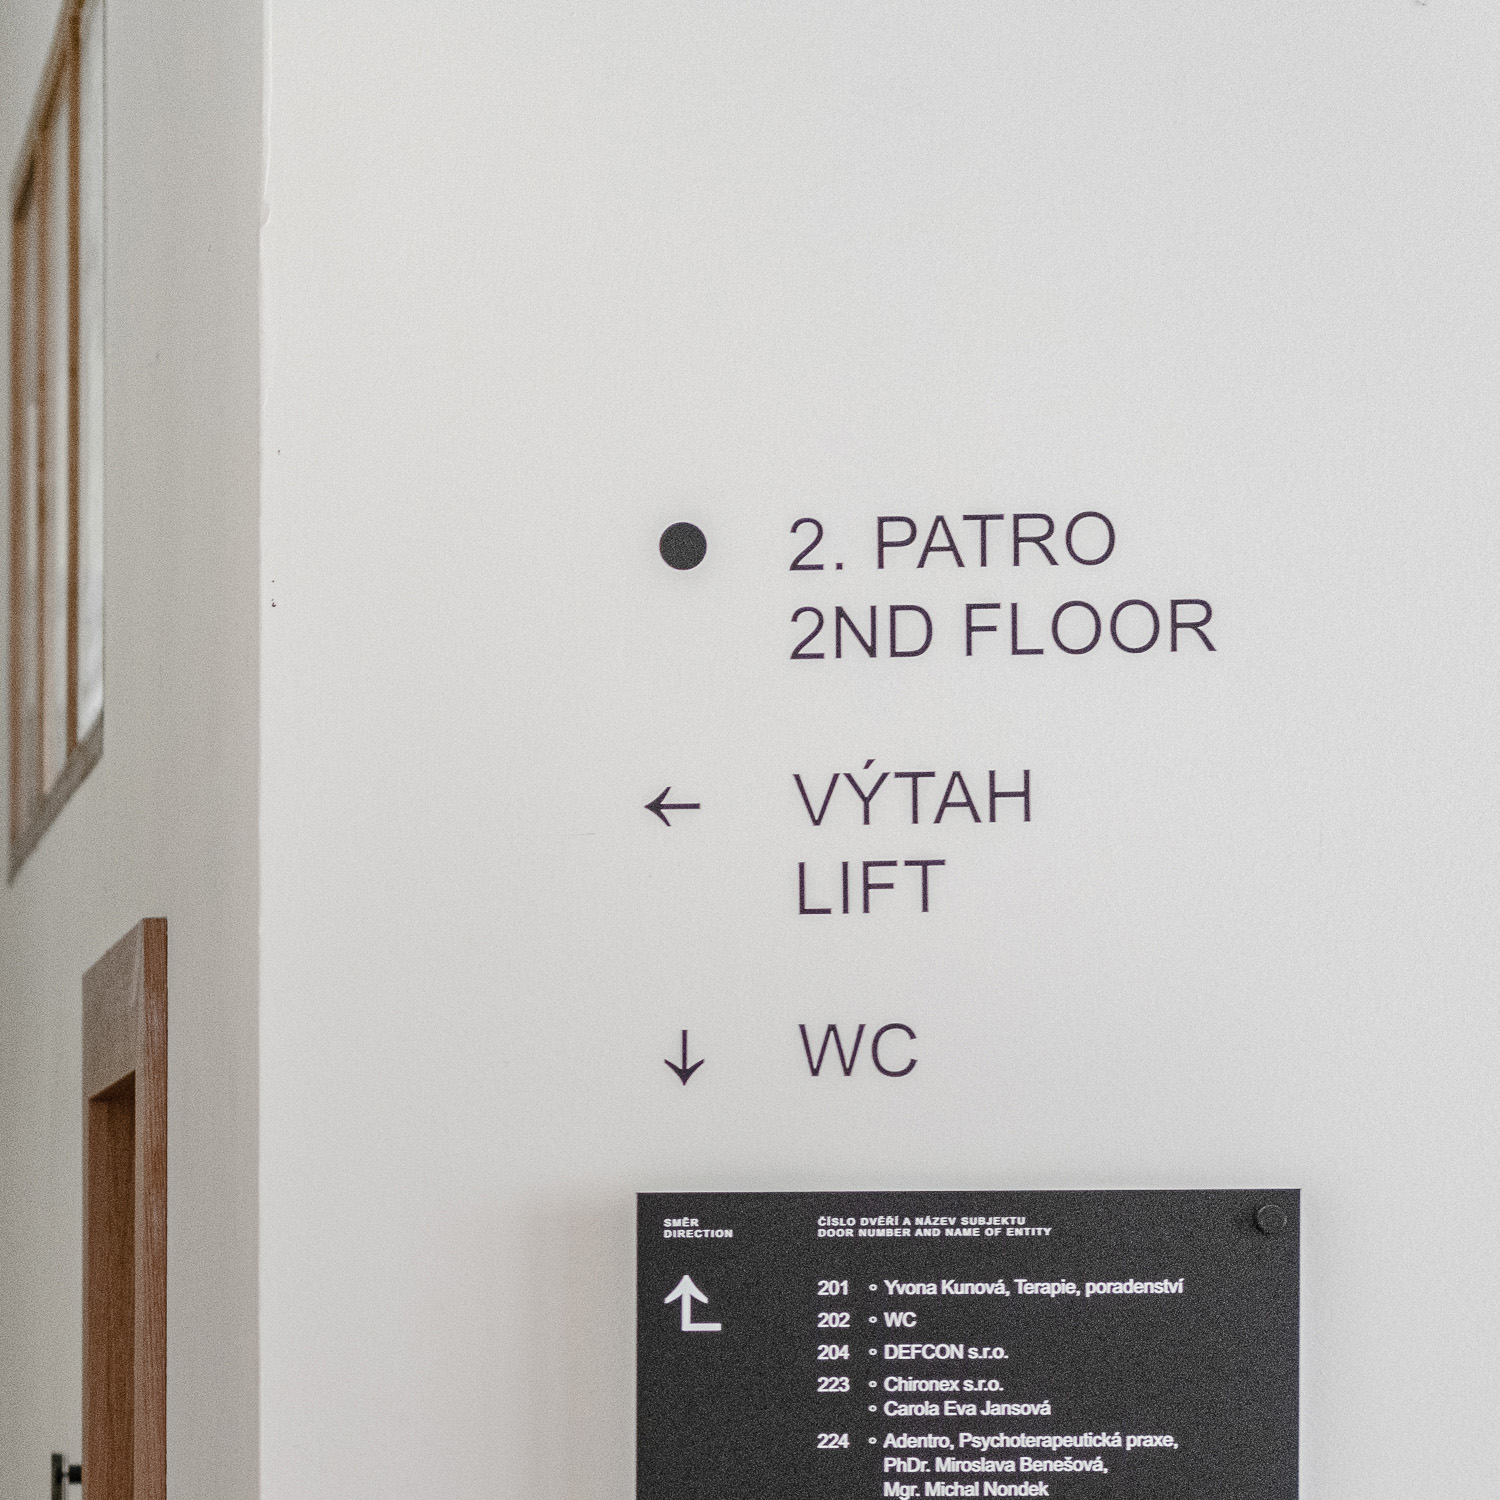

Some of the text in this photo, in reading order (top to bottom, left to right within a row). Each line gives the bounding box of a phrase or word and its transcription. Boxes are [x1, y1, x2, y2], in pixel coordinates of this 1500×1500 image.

[789, 510, 1116, 571] 2. PATRO
[790, 598, 1217, 660] 2ND FLOOR
[792, 758, 1031, 827] VÝTAH
[798, 859, 946, 915] LIFT
[798, 1022, 918, 1078] WC
[663, 1228, 734, 1239] DIRECTION
[817, 1226, 1053, 1238] DOOR NUMBER AND NAME OF ENTITY
[816, 1277, 1185, 1299] 201 Yvona Kunová, Terapie, poradenství
[816, 1311, 918, 1329] 202 WC
[816, 1343, 1009, 1361] 204 DEFCON s.r.o.
[816, 1375, 1005, 1393] 223 Chironex s.r.o.
[883, 1399, 1052, 1417] Carola Eva Jansová
[816, 1431, 1179, 1452] 224 Adentro, Psychoterapeutická praxe,
[883, 1455, 1109, 1475] PhDr. Miroslava Benešová,
[924, 1480, 980, 1498] Michal
[982, 1480, 1050, 1497] Nondek
